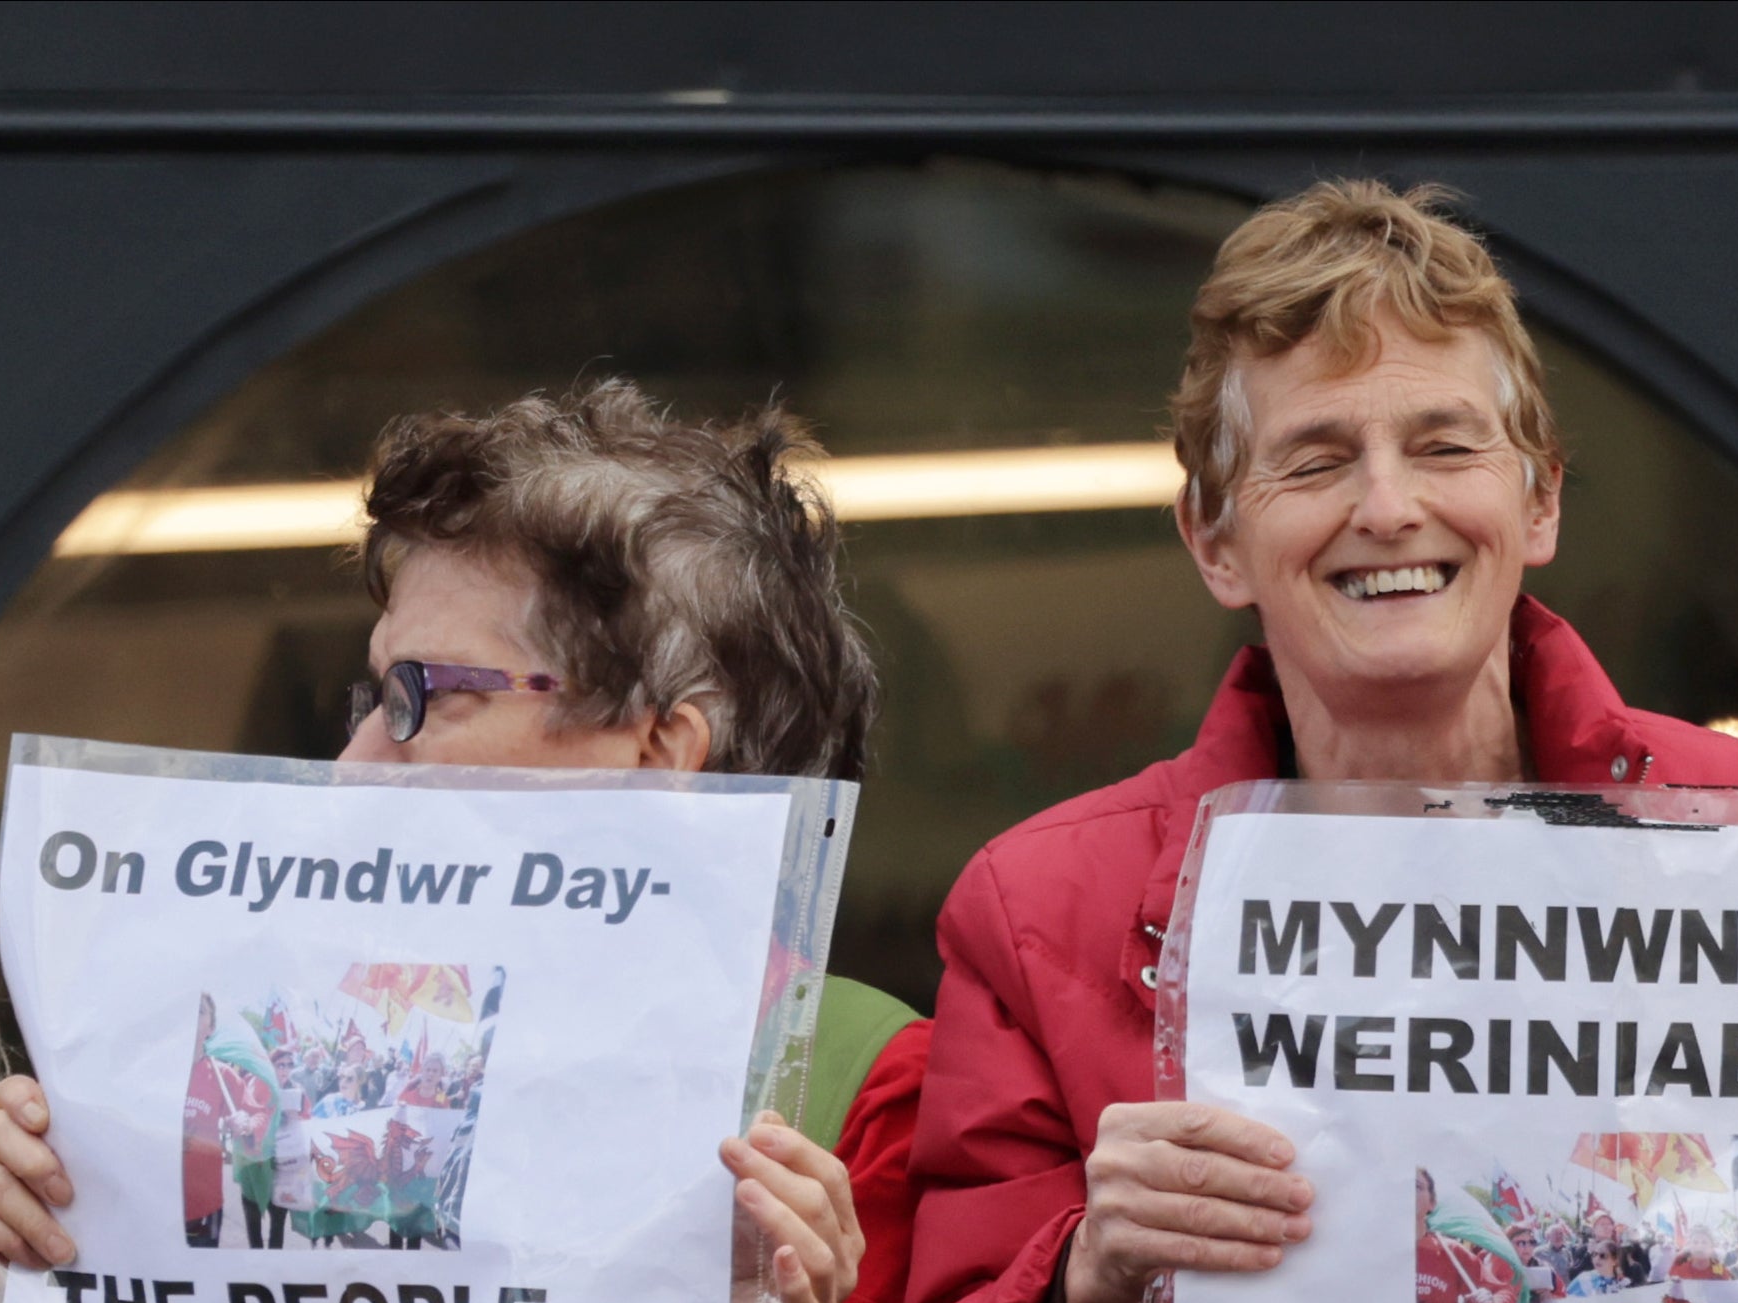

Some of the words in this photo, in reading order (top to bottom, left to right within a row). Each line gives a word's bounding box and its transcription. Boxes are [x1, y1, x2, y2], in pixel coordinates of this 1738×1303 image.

[39, 830, 146, 896] On
[173, 839, 487, 911] Glyndwr
[510, 852, 672, 925] Day-
